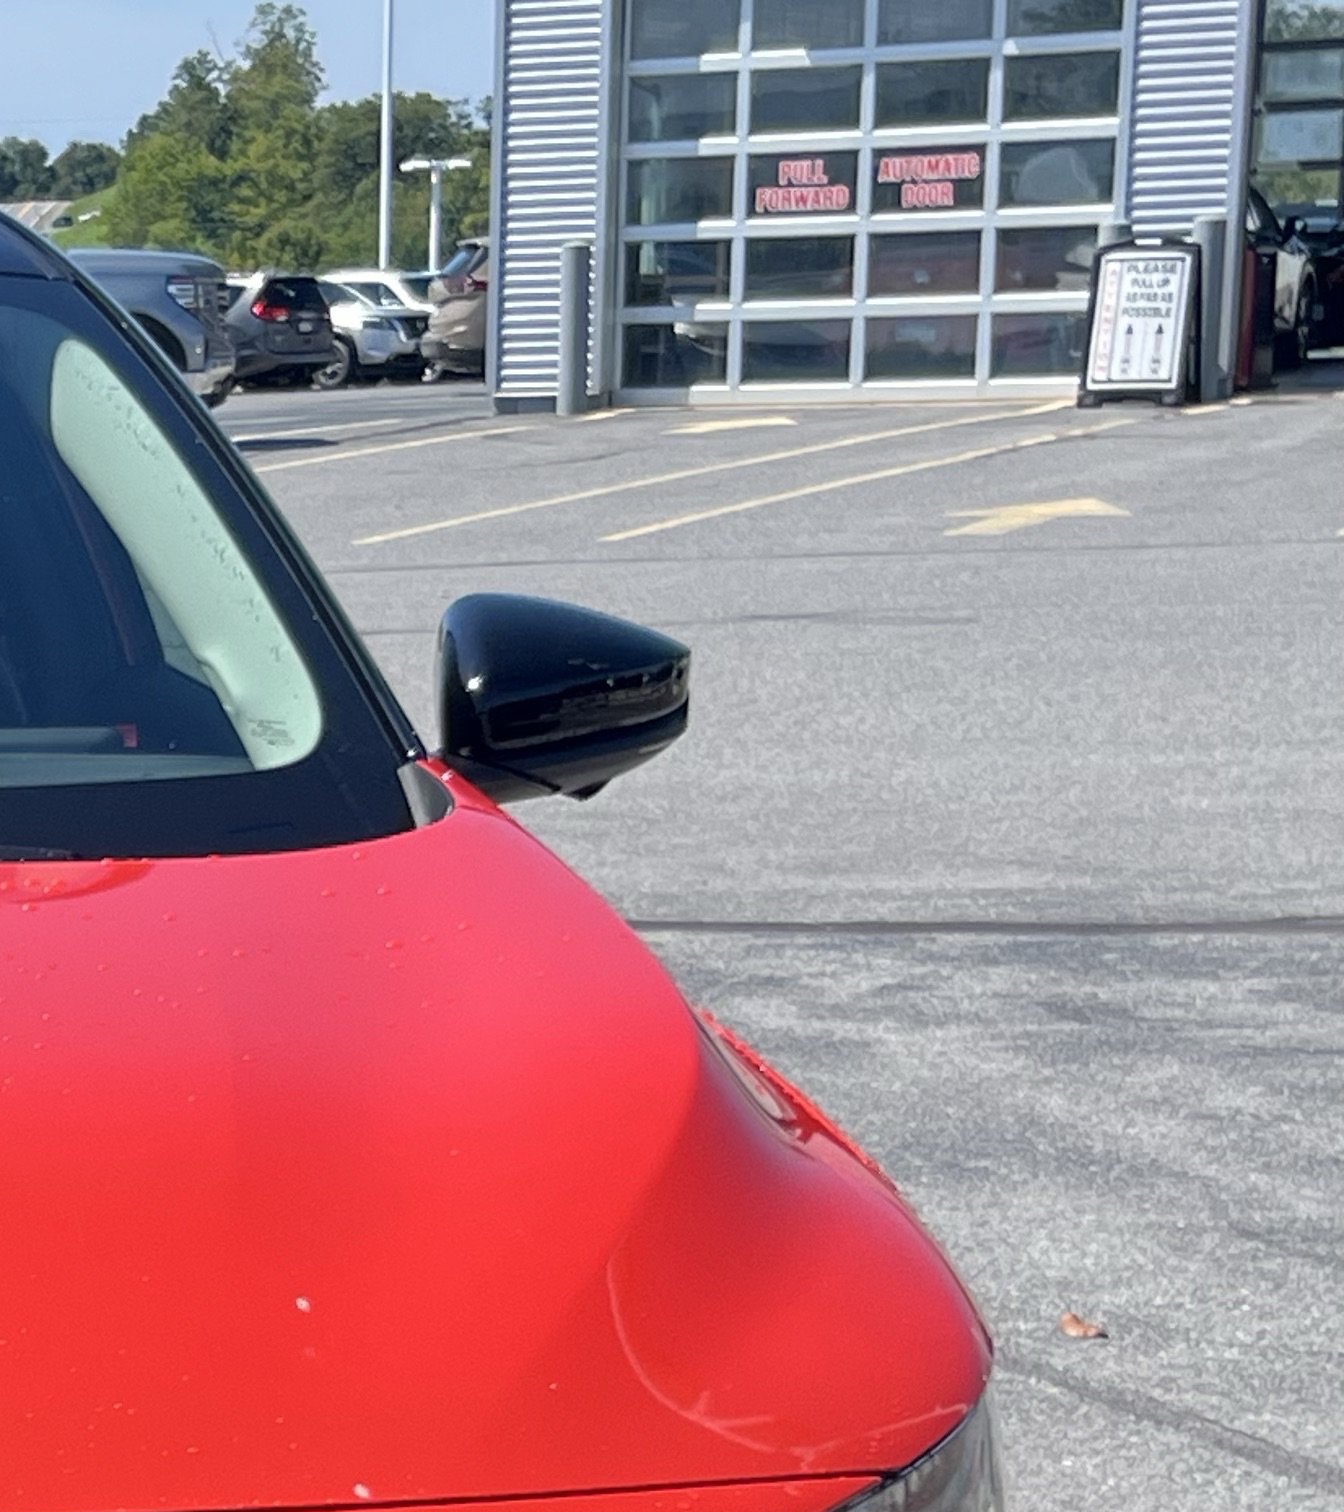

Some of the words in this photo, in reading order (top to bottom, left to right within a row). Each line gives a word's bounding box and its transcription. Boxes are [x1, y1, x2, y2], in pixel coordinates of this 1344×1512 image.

[779, 160, 828, 185] PULL
[878, 153, 980, 183] AUTOMATIC
[755, 184, 849, 213] FORWARD
[901, 181, 954, 208] DOOR
[1127, 261, 1177, 274] PLEASE
[1131, 278, 1154, 289] PULL
[1156, 277, 1171, 288] UP
[1122, 306, 1172, 318] POSSIBLE
